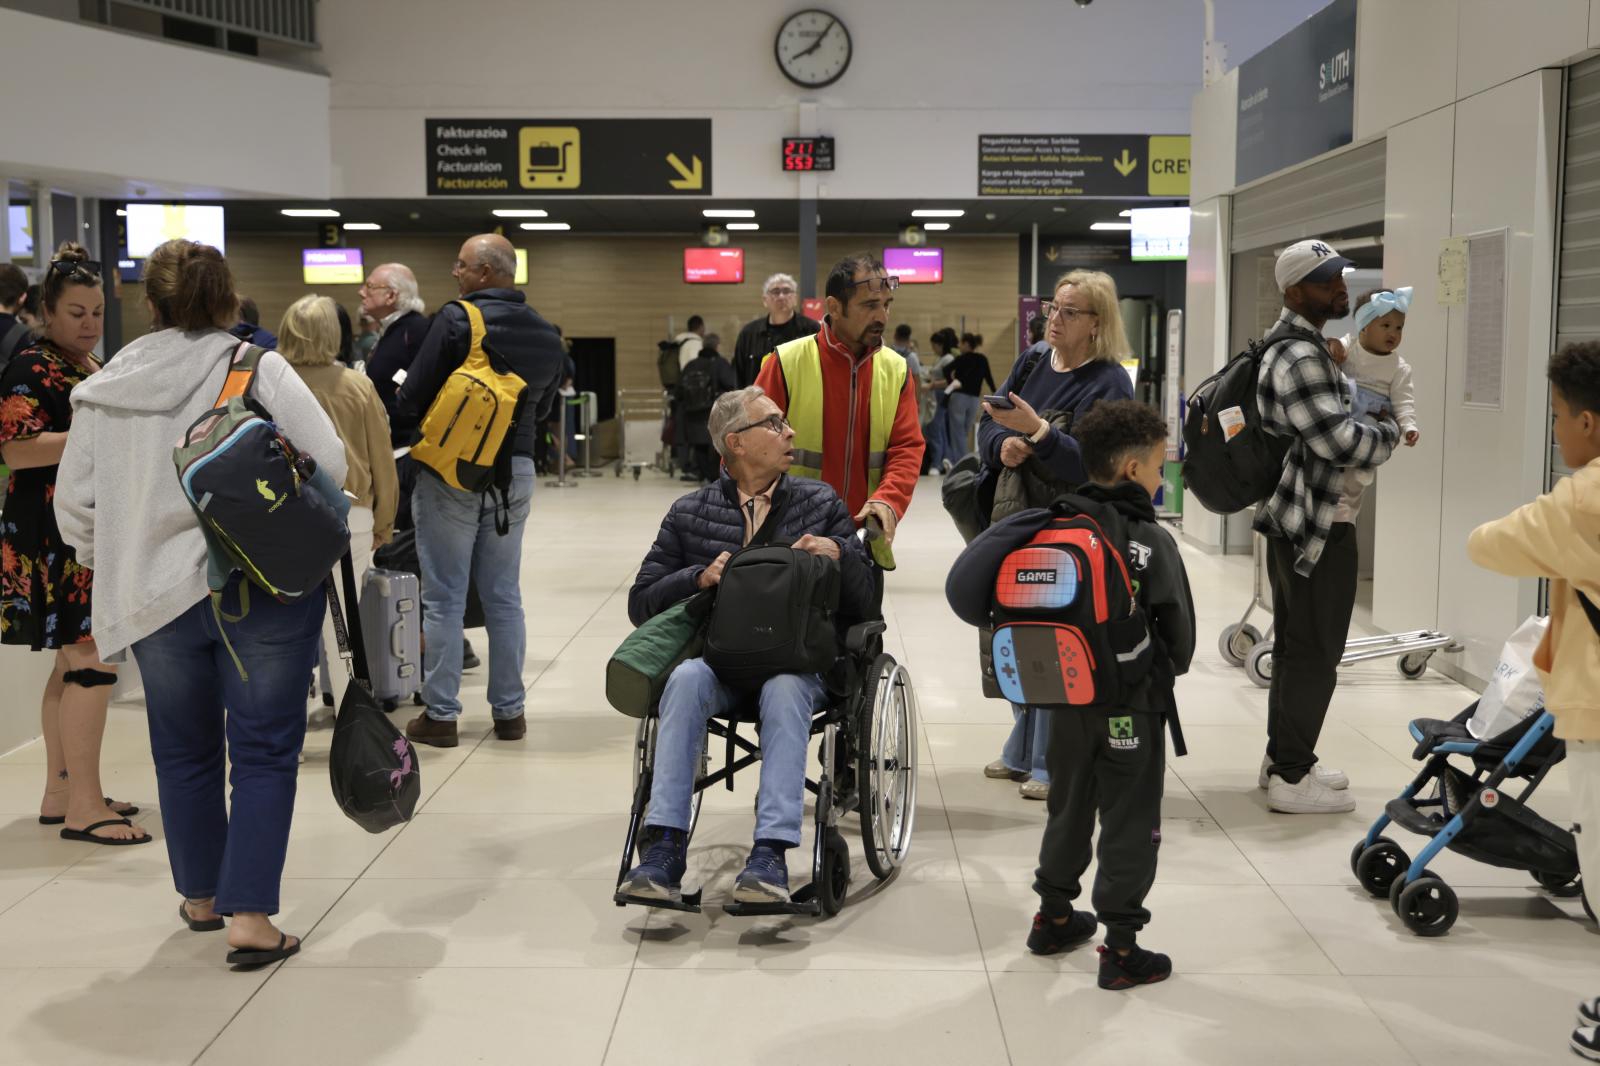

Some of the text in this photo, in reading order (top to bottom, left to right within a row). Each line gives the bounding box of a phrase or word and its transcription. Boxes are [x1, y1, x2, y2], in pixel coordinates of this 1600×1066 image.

[437, 126, 508, 139] Fakturazioa
[437, 144, 487, 156] Check-in
[437, 160, 503, 173] Facturation
[1152, 159, 1191, 174] CRE
[438, 176, 509, 189] Facturación
[708, 226, 721, 246] 5
[906, 226, 919, 246] 6
[1017, 572, 1055, 582] GAME
